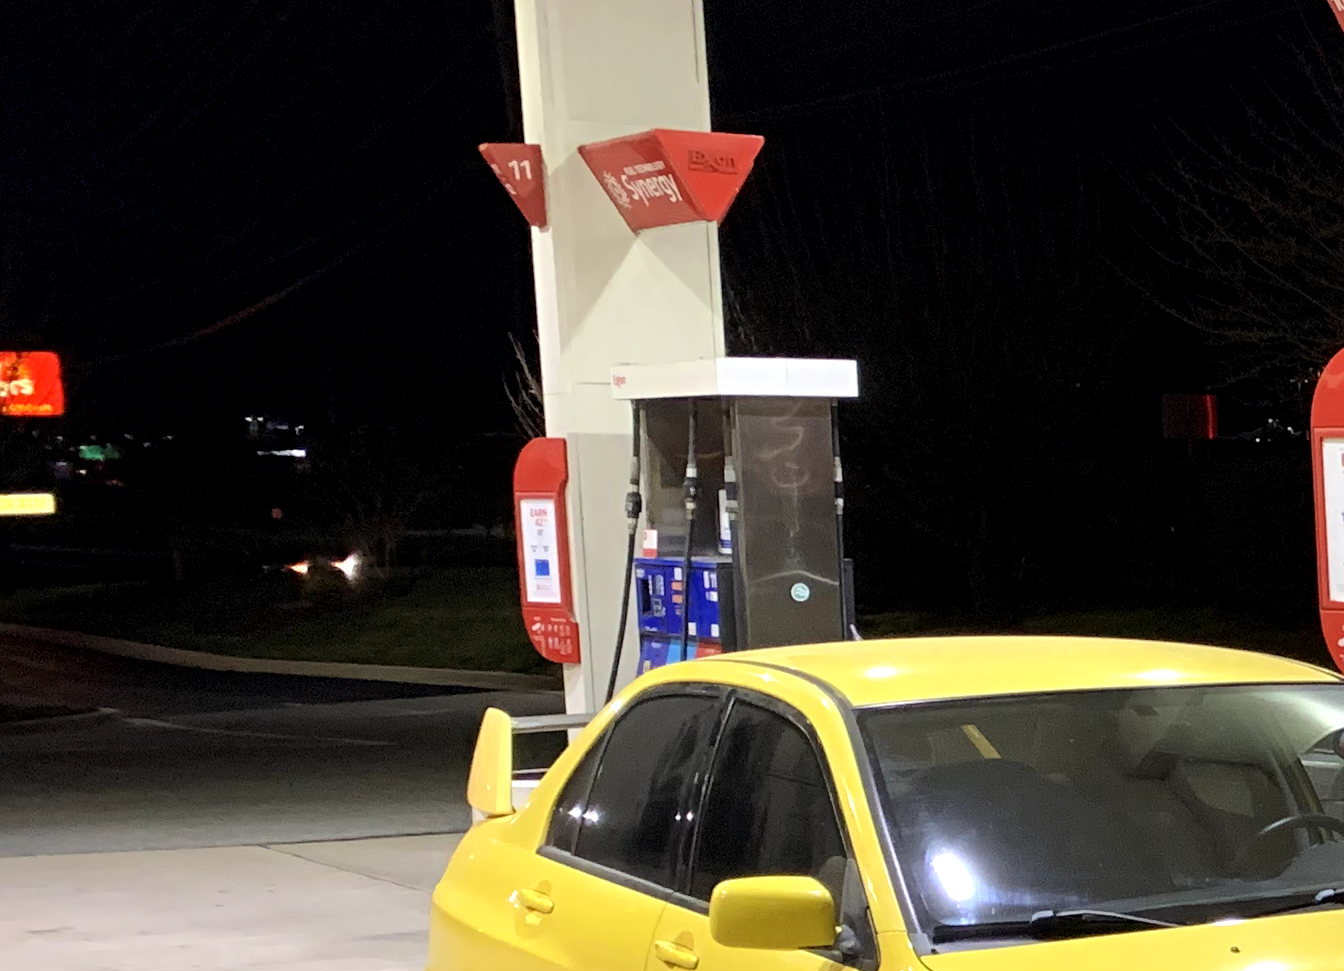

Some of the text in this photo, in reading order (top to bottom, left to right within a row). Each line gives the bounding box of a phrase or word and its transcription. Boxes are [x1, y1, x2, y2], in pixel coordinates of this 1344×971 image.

[508, 160, 532, 181] 11
[620, 174, 683, 207] Synergy
[529, 508, 548, 518] EARN
